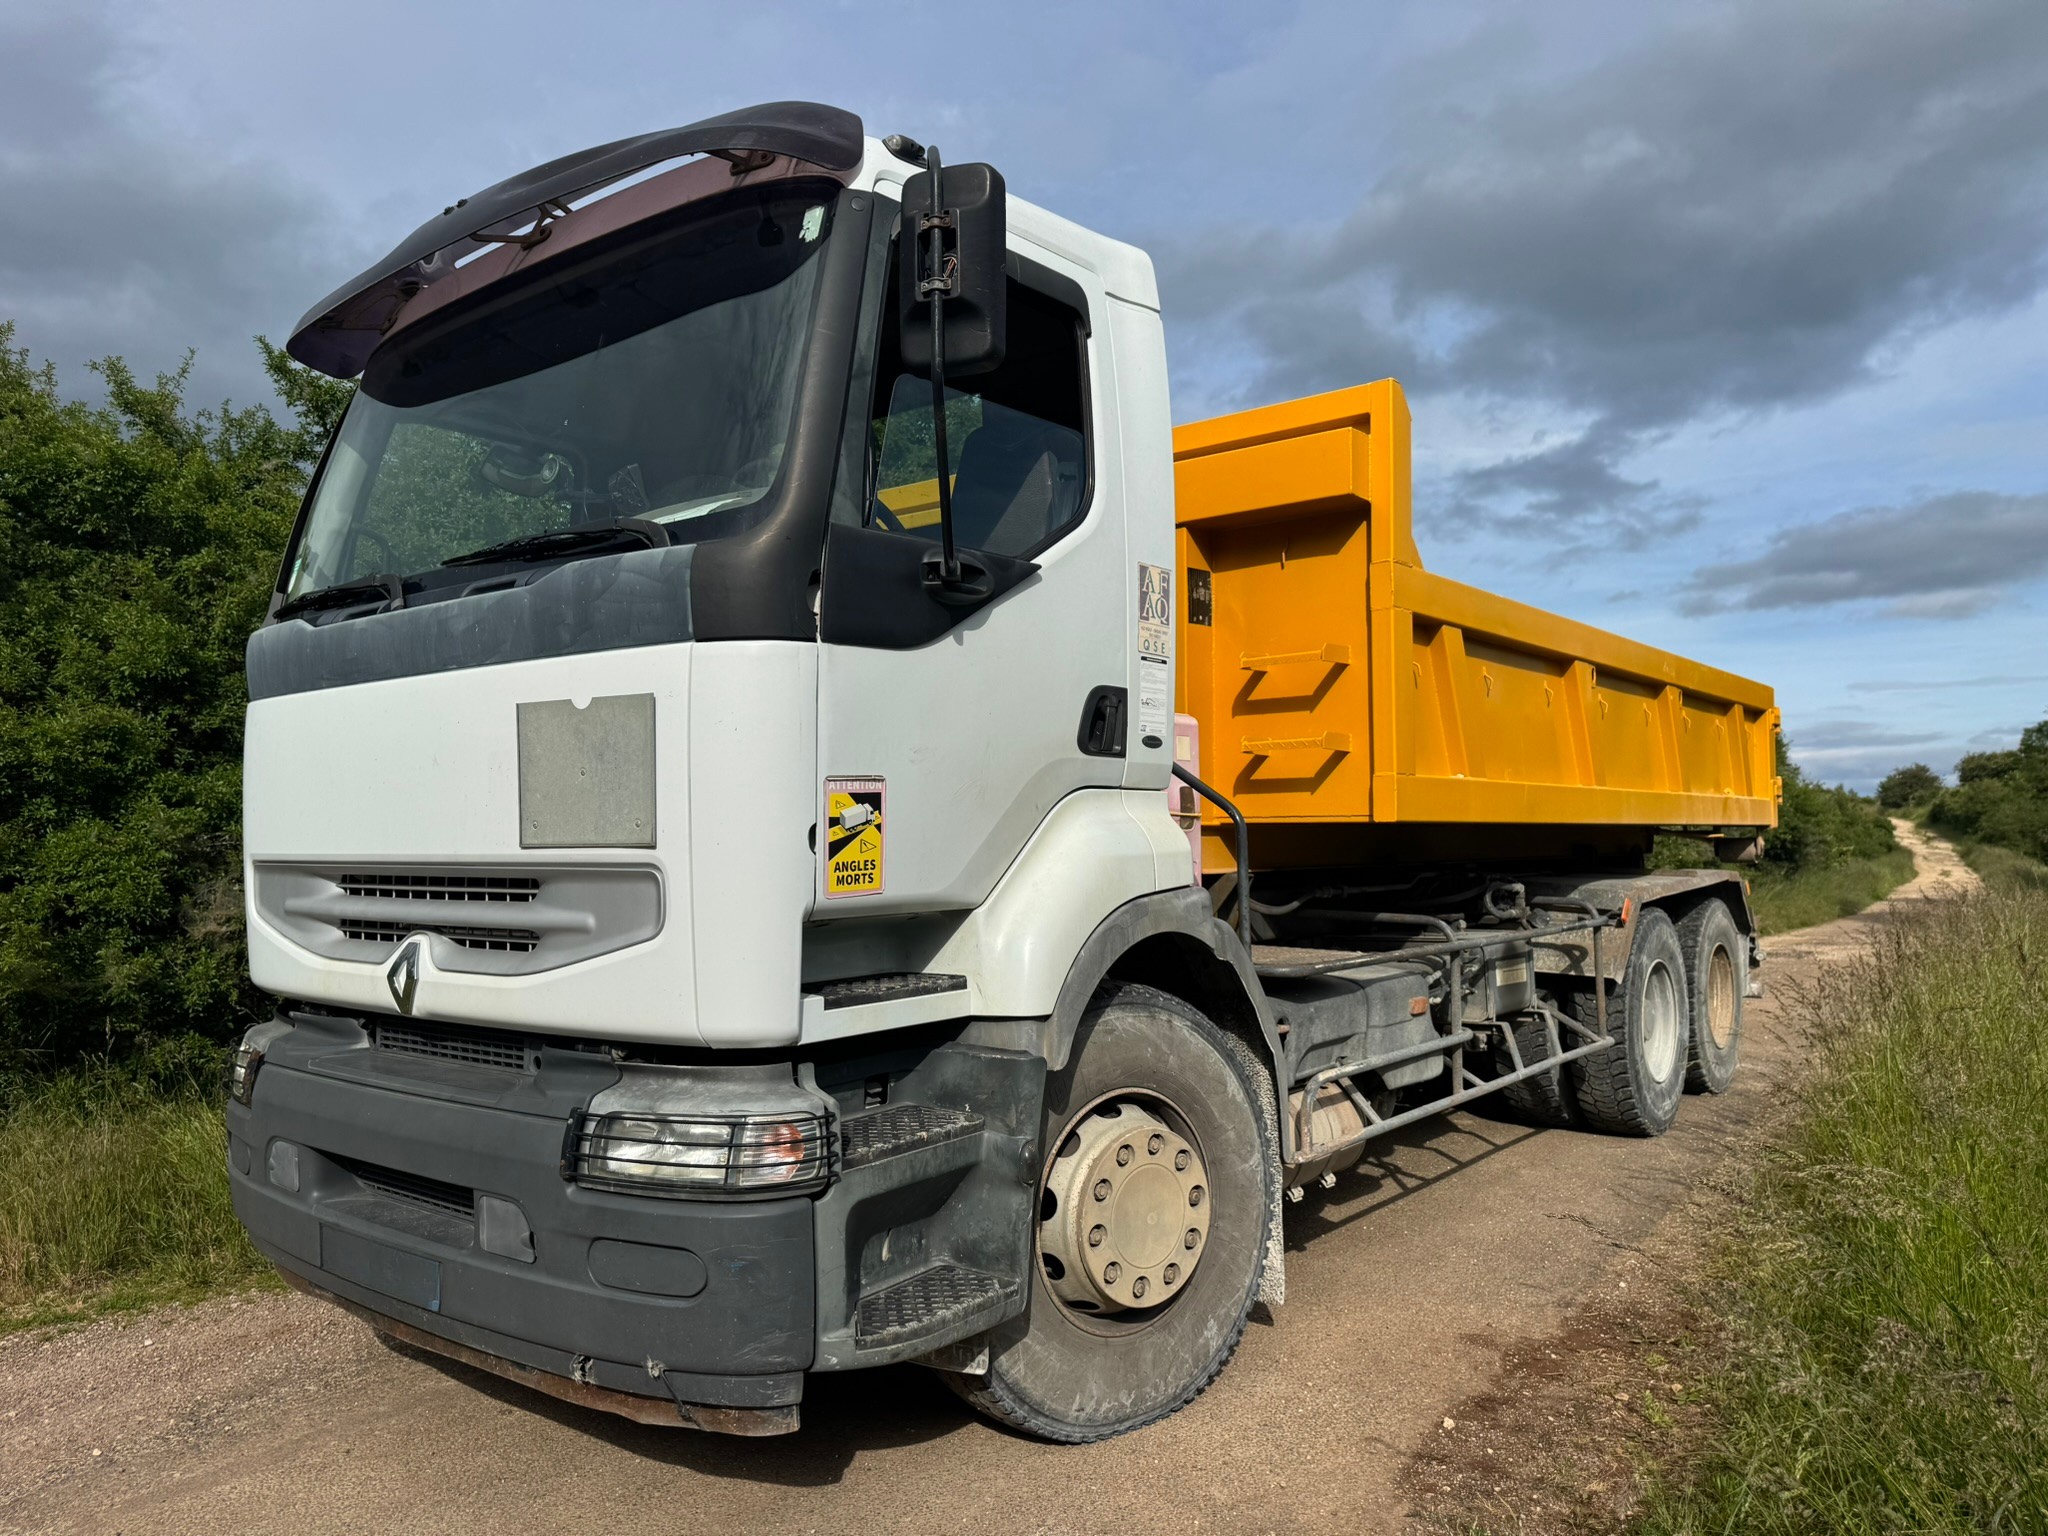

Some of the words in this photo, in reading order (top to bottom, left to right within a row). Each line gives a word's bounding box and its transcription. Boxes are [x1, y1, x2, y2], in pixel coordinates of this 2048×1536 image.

[828, 781, 882, 790] ATTENTION
[834, 859, 876, 873] ANGLES
[836, 873, 874, 886] MORTS
